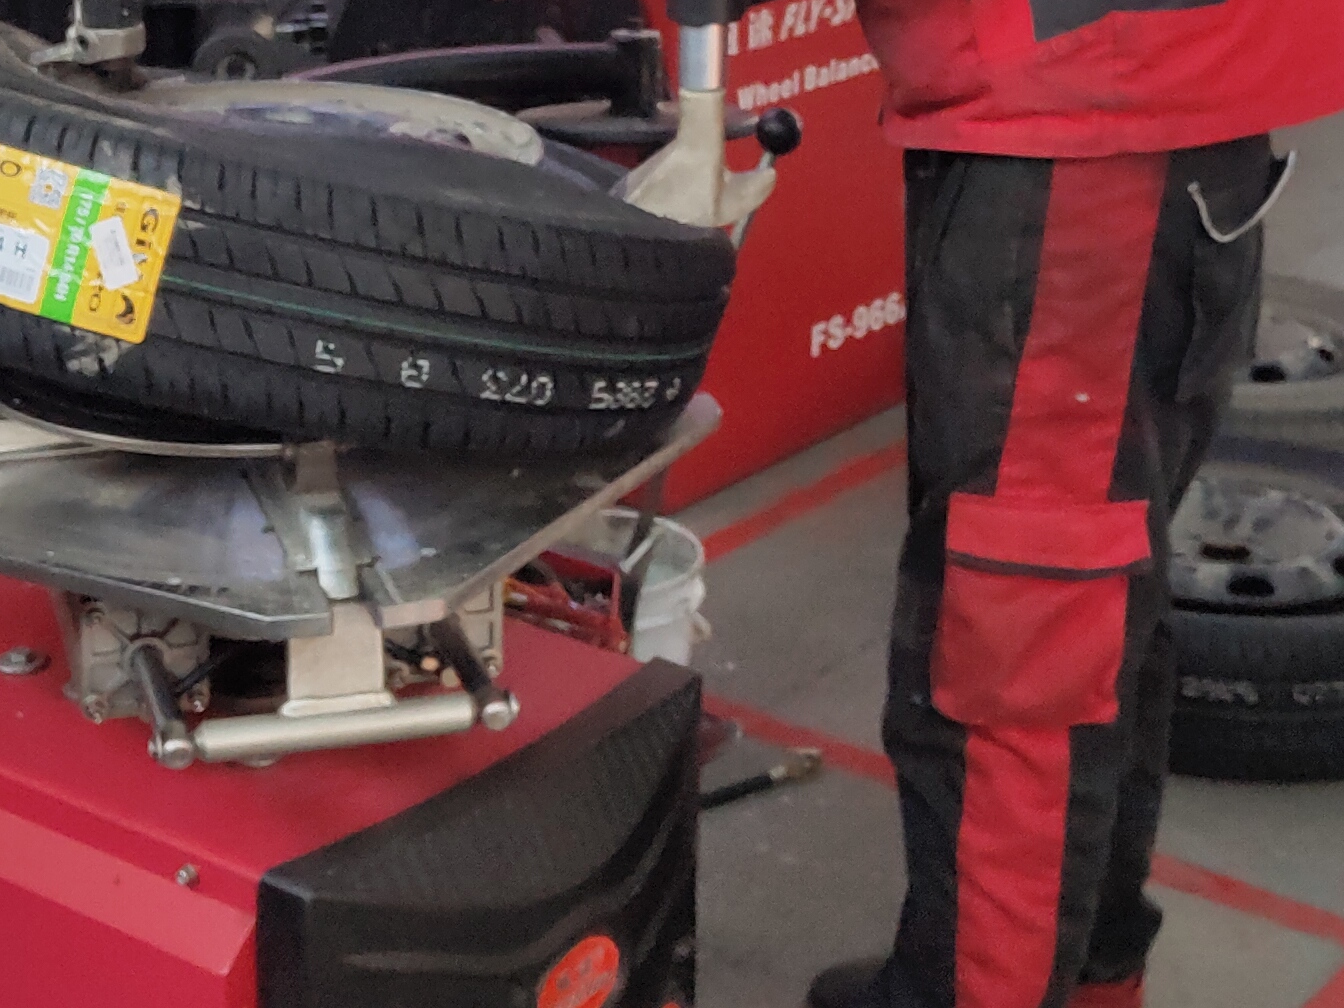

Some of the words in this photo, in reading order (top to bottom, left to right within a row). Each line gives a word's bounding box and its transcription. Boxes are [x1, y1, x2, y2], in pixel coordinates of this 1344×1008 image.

[737, 69, 800, 111] Wheel
[14, 244, 29, 259] H
[810, 291, 906, 358] FS-966
